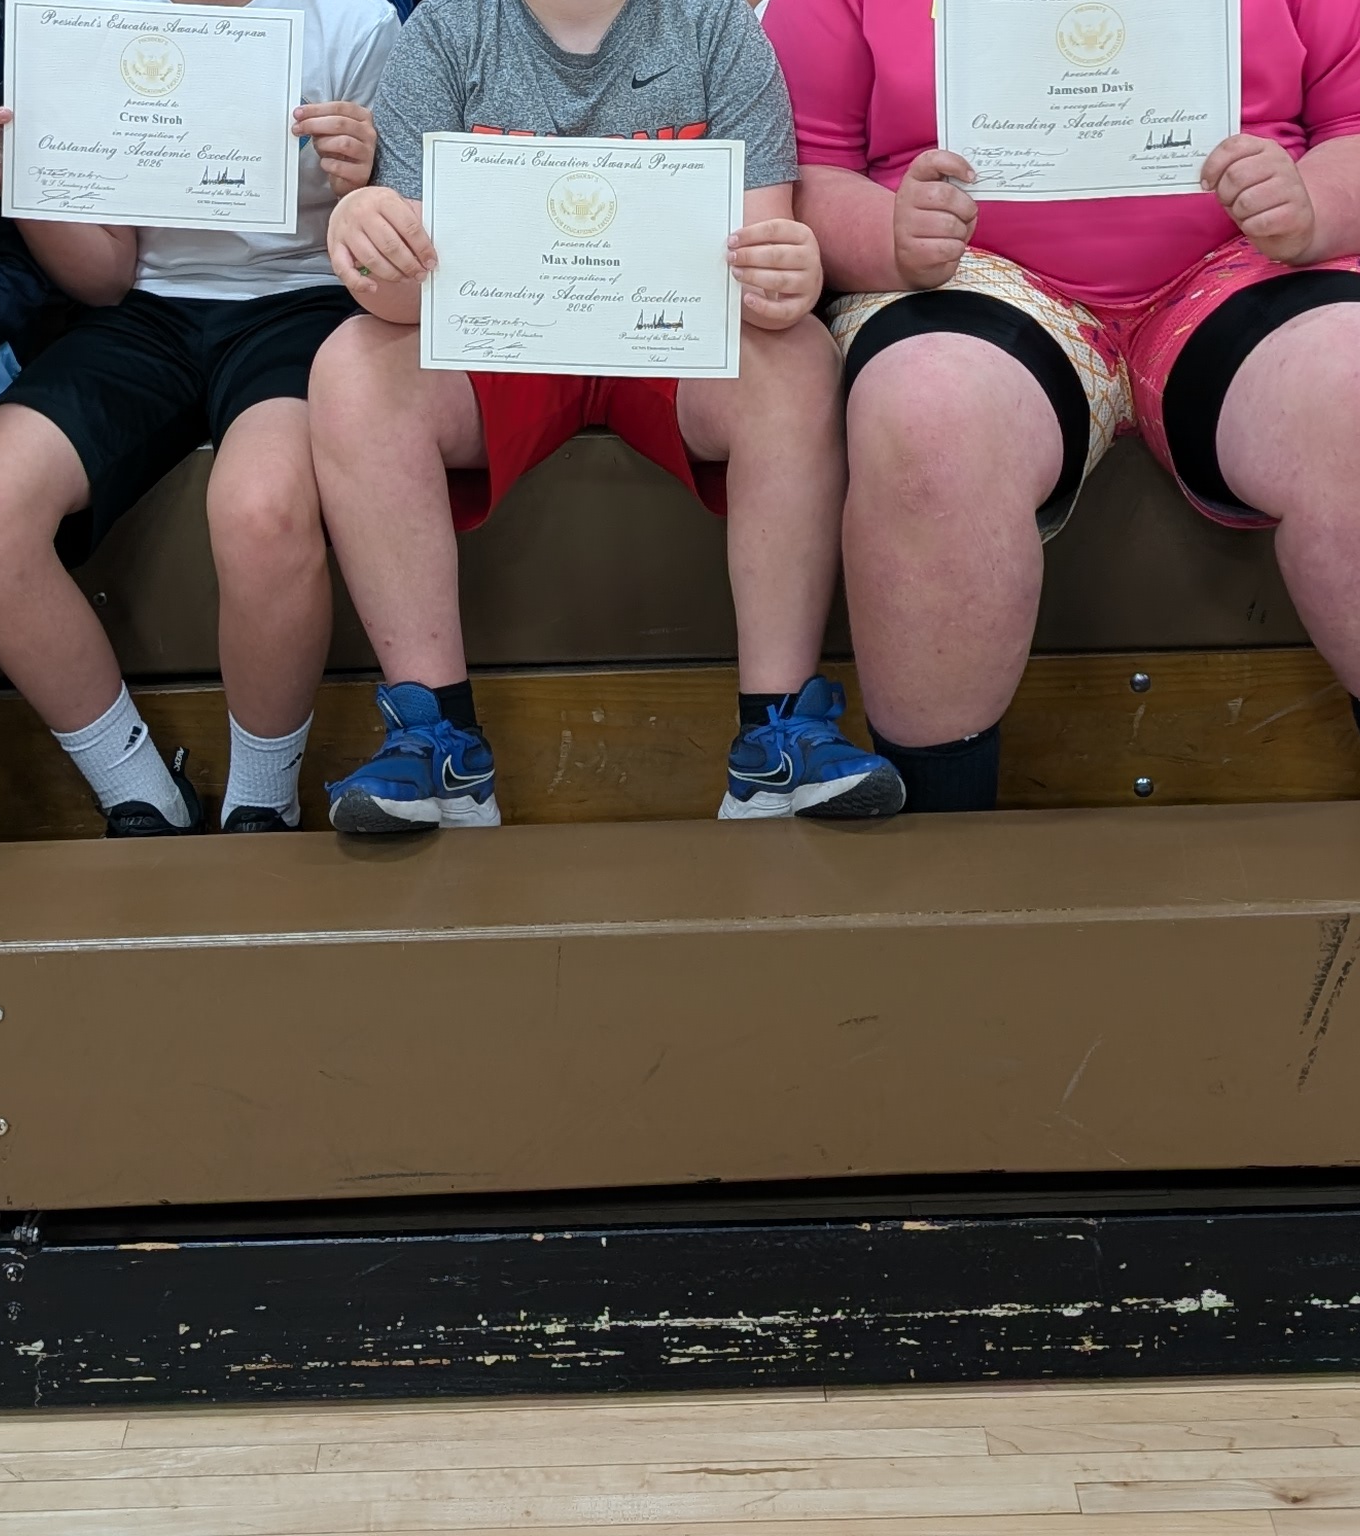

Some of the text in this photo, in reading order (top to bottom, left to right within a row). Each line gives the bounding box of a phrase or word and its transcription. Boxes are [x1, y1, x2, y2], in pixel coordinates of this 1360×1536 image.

[40, 8, 266, 42] President's Education Awards Program
[1047, 81, 1133, 94] Jameson Davis
[119, 111, 182, 124] Crew Stroh
[972, 108, 1208, 135] Outstanding Academic Excellence
[1076, 129, 1105, 139] 2026
[38, 134, 261, 161] Outstanding Academic Excellence
[136, 157, 163, 167] 2026
[460, 145, 704, 176] President's Education Awards Program
[541, 254, 620, 266] Max Johnson
[459, 279, 701, 305] Outstanding Academic Excellence
[565, 302, 594, 312] 2026
